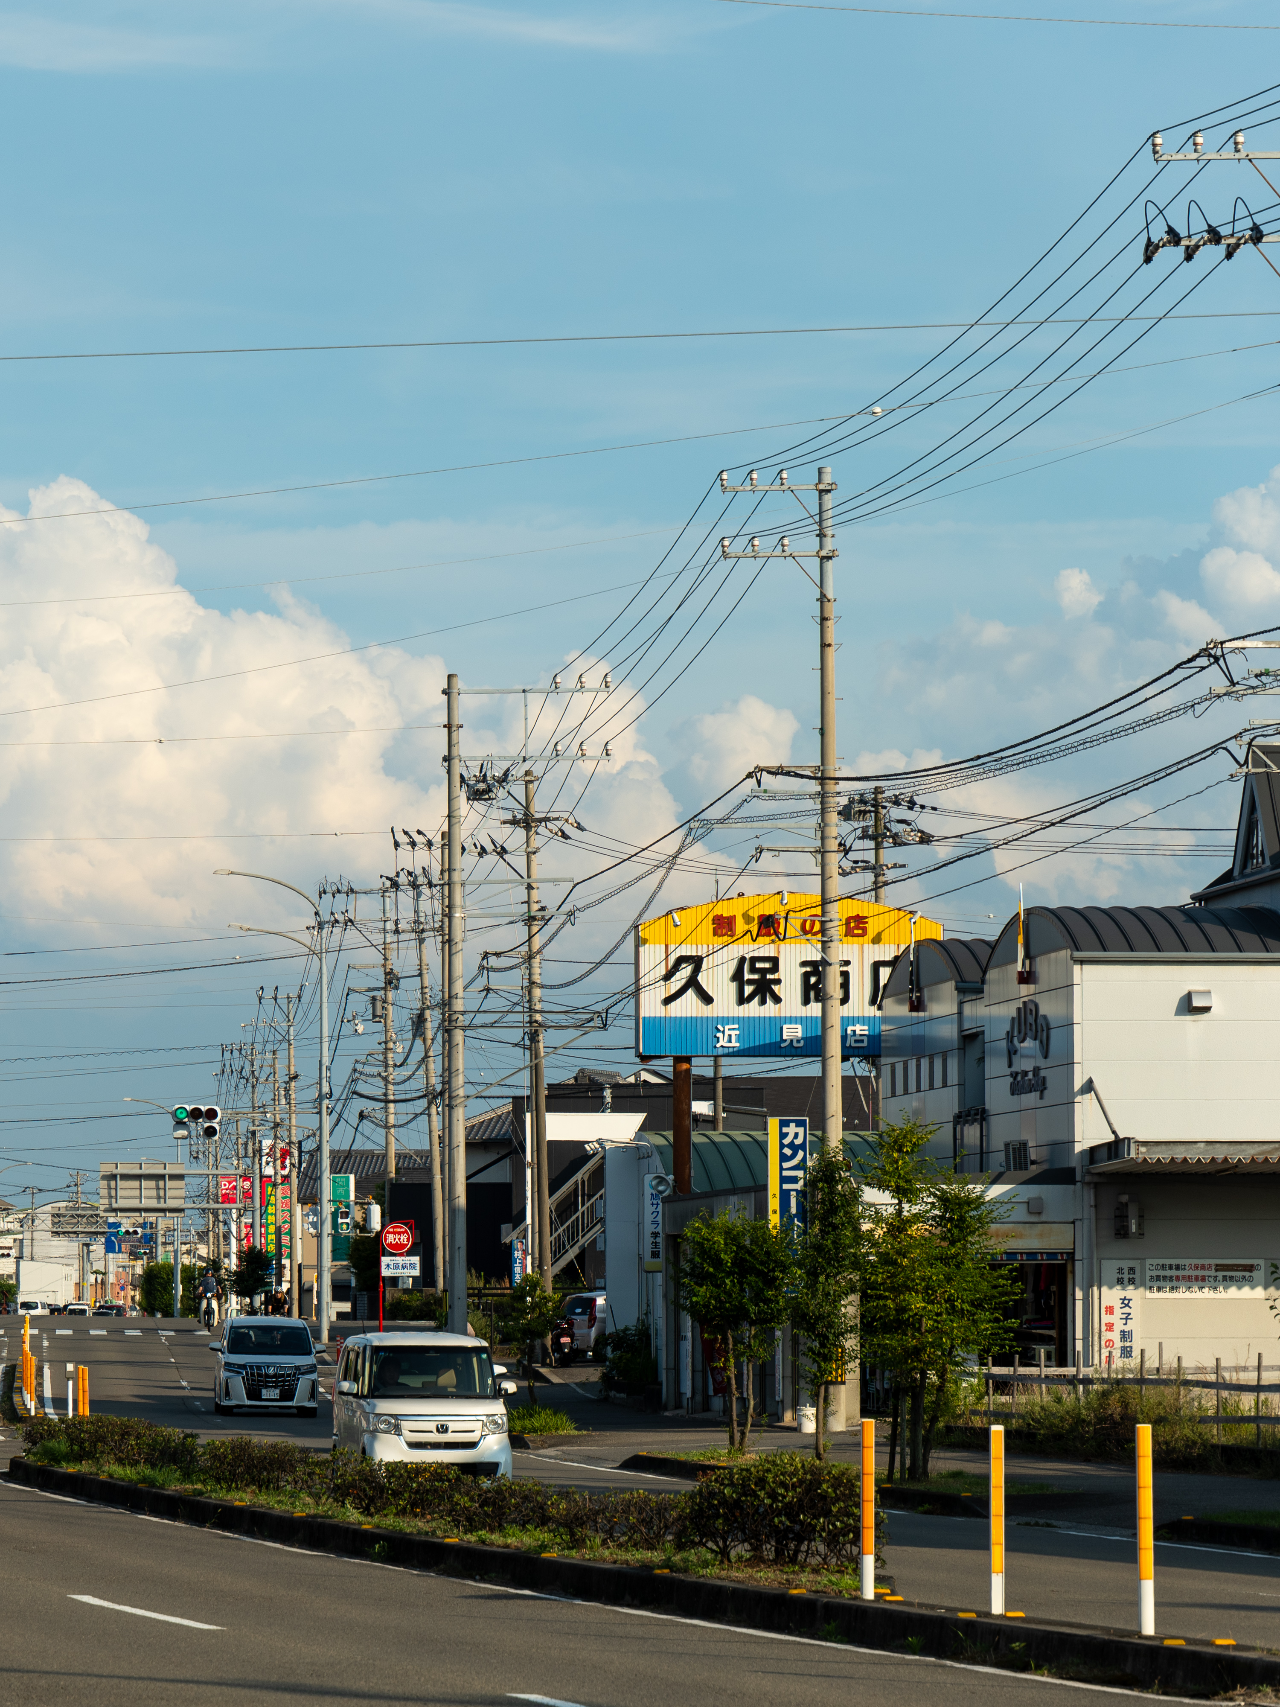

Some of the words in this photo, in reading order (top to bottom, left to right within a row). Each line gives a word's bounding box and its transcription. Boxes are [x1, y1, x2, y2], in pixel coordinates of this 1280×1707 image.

[715, 1024, 869, 1048] 近見店
[650, 1192, 661, 1259] 鳩サクラ学生服
[386, 1233, 408, 1244] 消火栓
[1116, 1266, 1125, 1286] 北校
[1127, 1266, 1136, 1286] 西校
[1119, 1296, 1133, 1359] 女子制服
